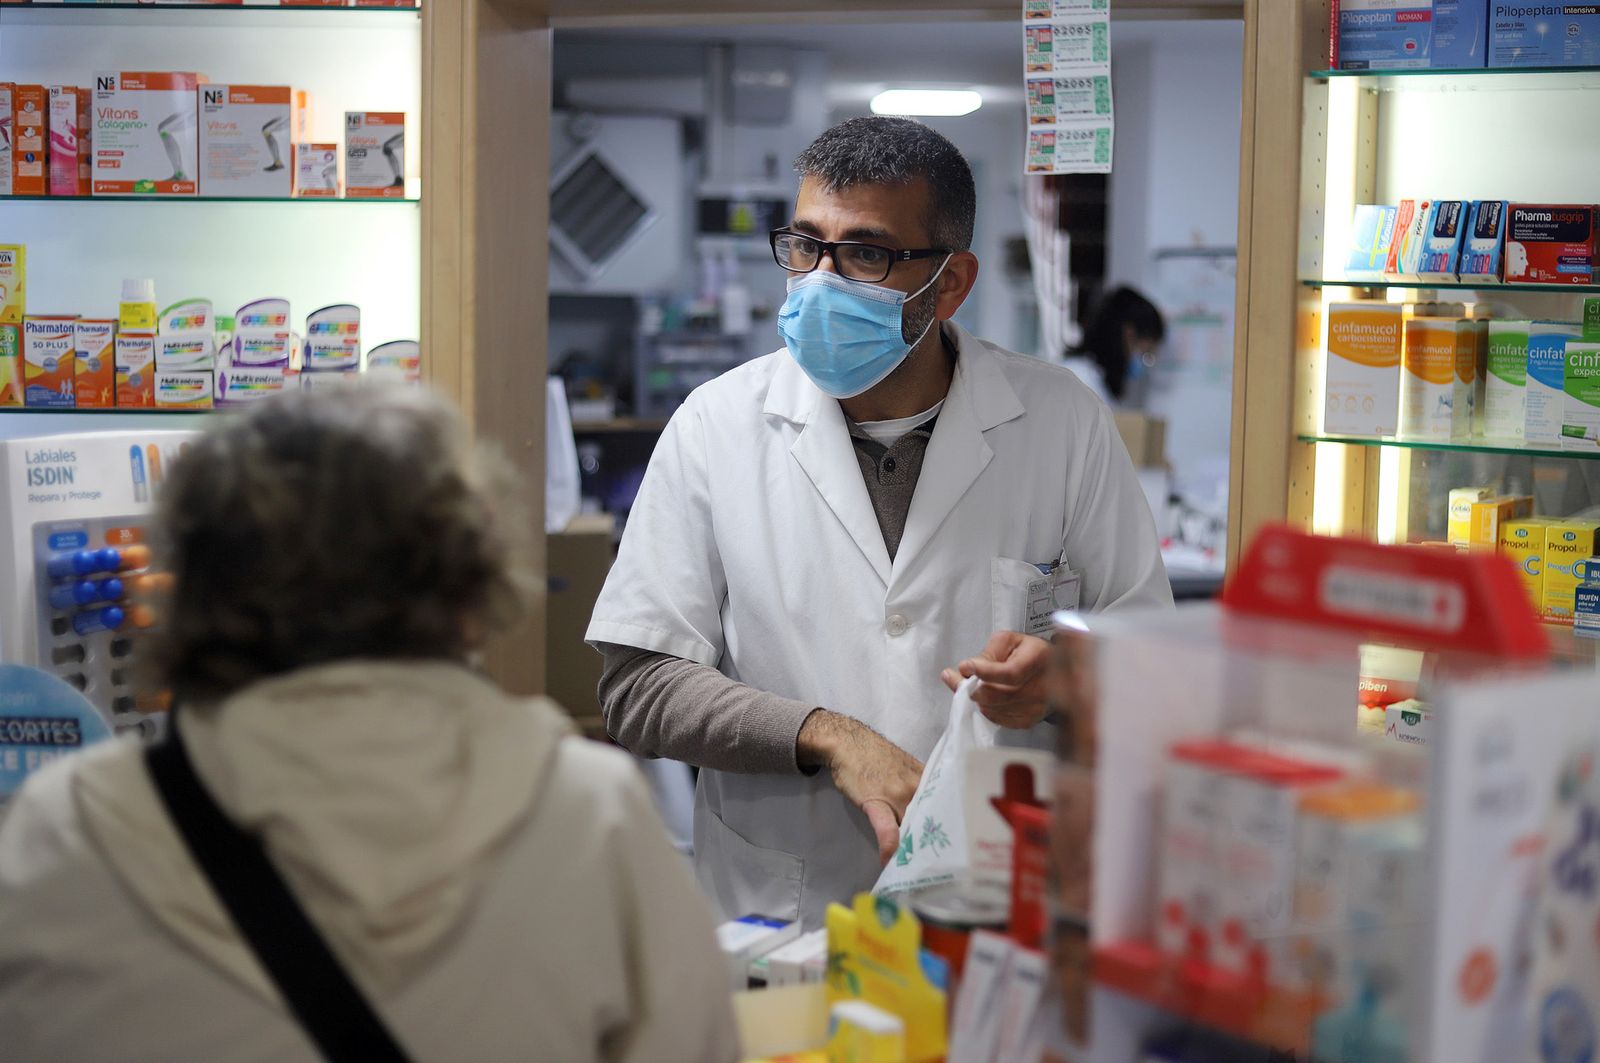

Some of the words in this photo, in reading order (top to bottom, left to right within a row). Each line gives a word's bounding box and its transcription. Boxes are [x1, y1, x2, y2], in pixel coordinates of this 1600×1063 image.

[1496, 5, 1561, 18] Pilopeptan
[1564, 6, 1596, 14] Intensive
[1341, 12, 1392, 25] Pilopeptan
[1397, 13, 1423, 22] WOMAN
[97, 108, 139, 120] Vitans
[1515, 210, 1584, 224] Pharmatusgrip
[26, 322, 74, 334] Pharmaton
[77, 325, 110, 334] Pharmaton
[1333, 322, 1397, 336] cinfamucol
[33, 341, 47, 349] 50
[51, 341, 69, 349] PLUS
[117, 339, 151, 348] Pharmaton
[1529, 347, 1564, 361] cinfat
[25, 448, 77, 464] Labiales
[27, 466, 74, 487] ISDIN
